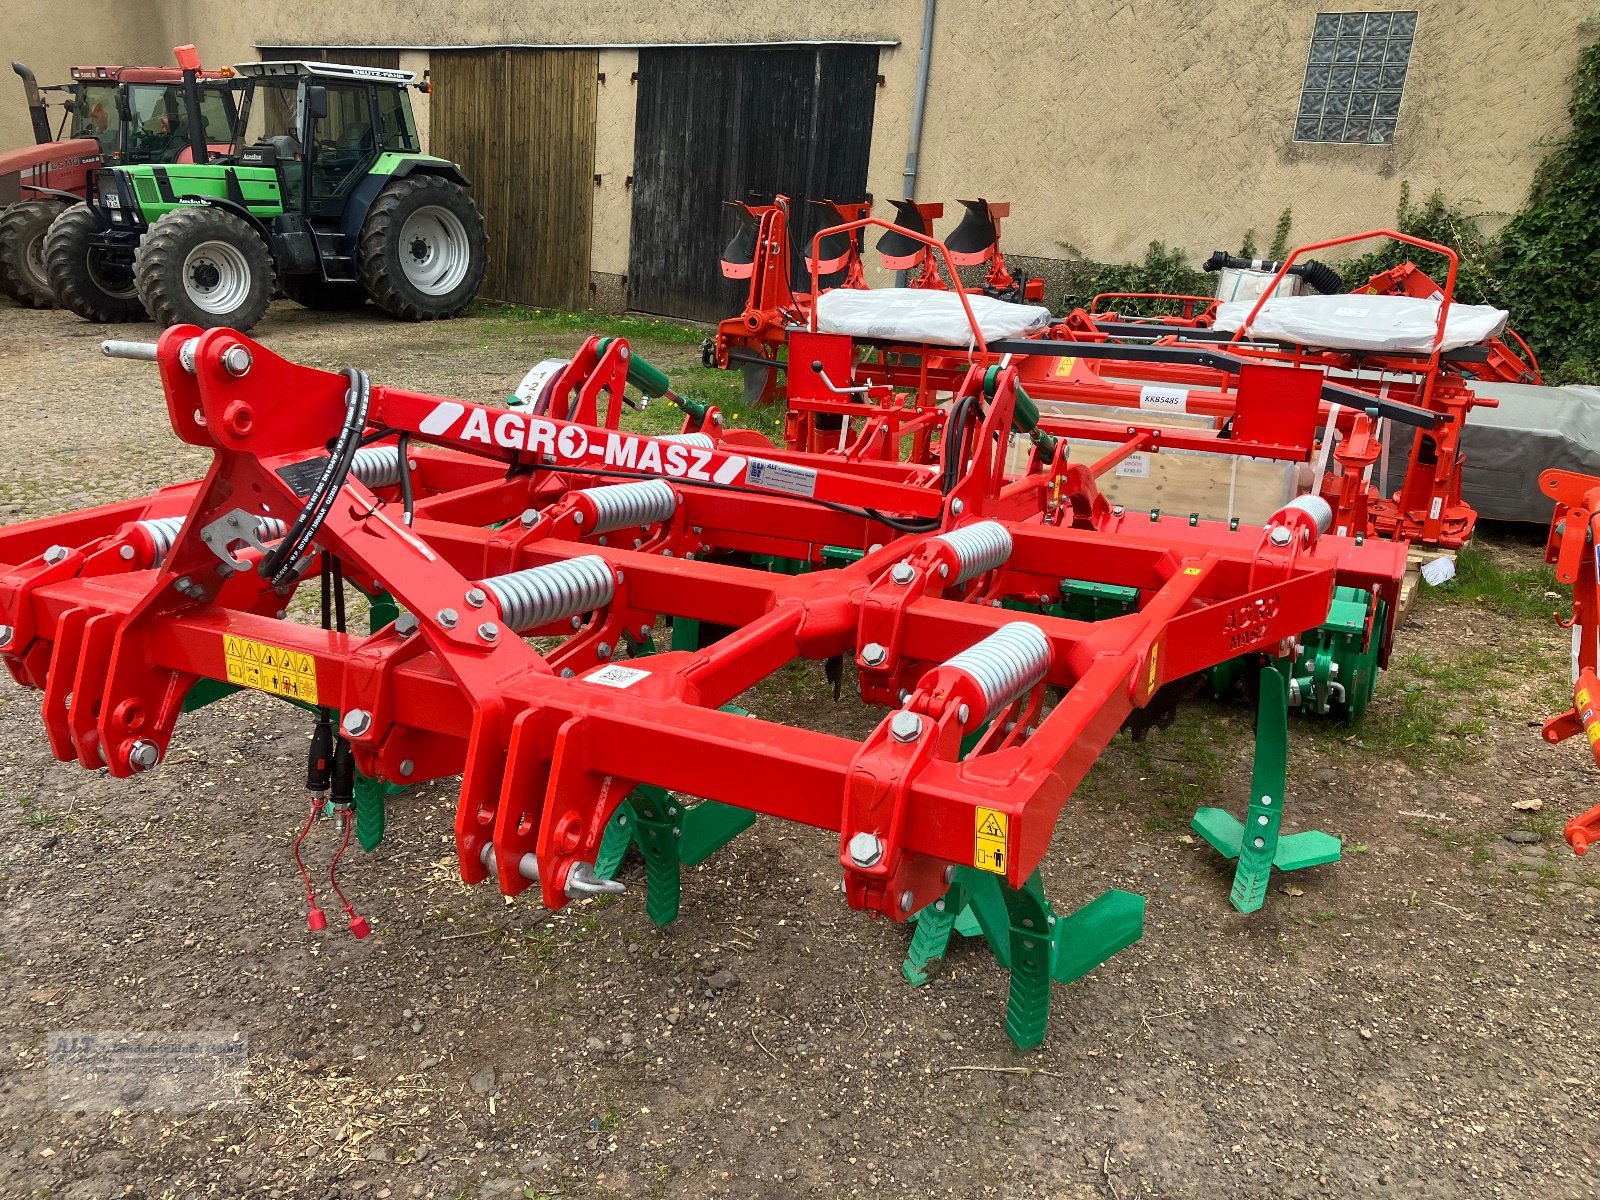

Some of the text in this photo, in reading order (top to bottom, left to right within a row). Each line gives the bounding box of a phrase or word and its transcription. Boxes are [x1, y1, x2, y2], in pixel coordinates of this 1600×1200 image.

[529, 382, 539, 391] 2
[523, 395, 532, 406] 3
[1144, 395, 1180, 405] KKB5485
[460, 408, 713, 481] AGRO-MASZ
